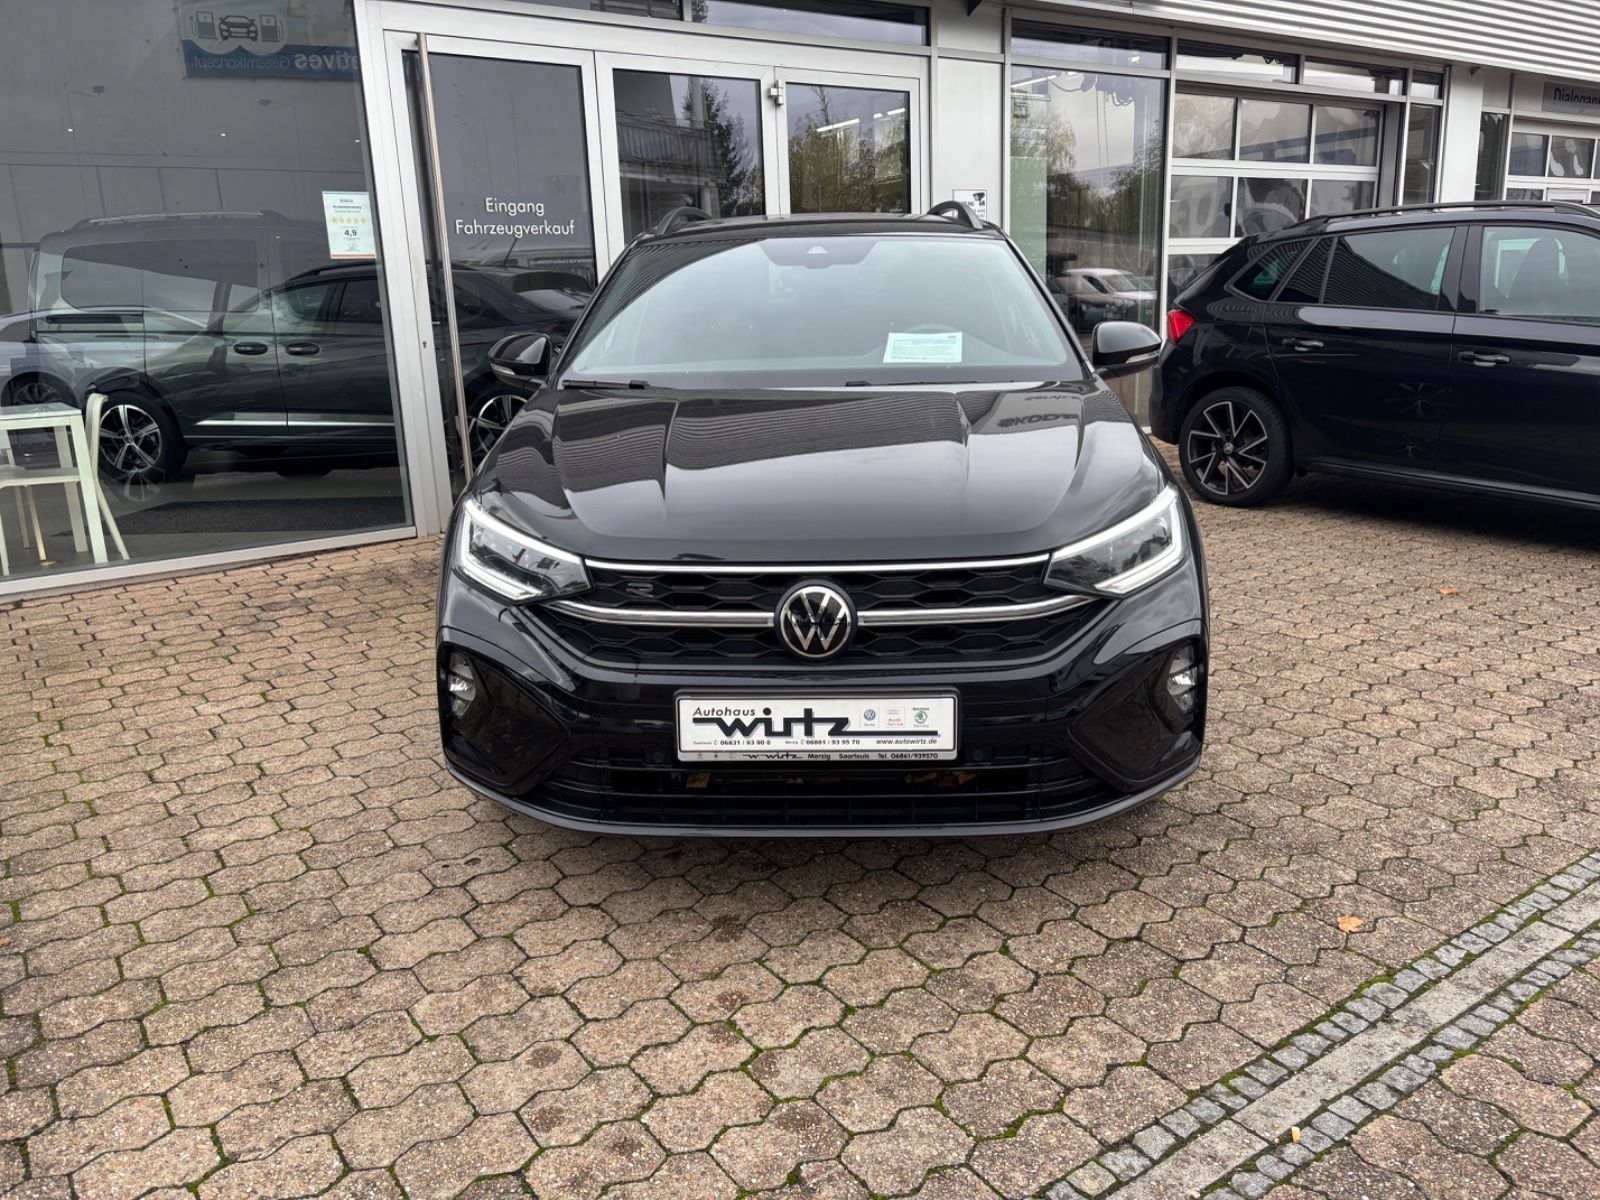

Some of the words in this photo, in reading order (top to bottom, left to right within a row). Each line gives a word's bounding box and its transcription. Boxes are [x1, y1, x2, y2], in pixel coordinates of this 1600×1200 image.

[485, 197, 545, 216] Eingang
[344, 229, 357, 237] 4,9
[455, 219, 576, 238] Fahrzeugverkauf
[692, 706, 756, 716] Autohaus
